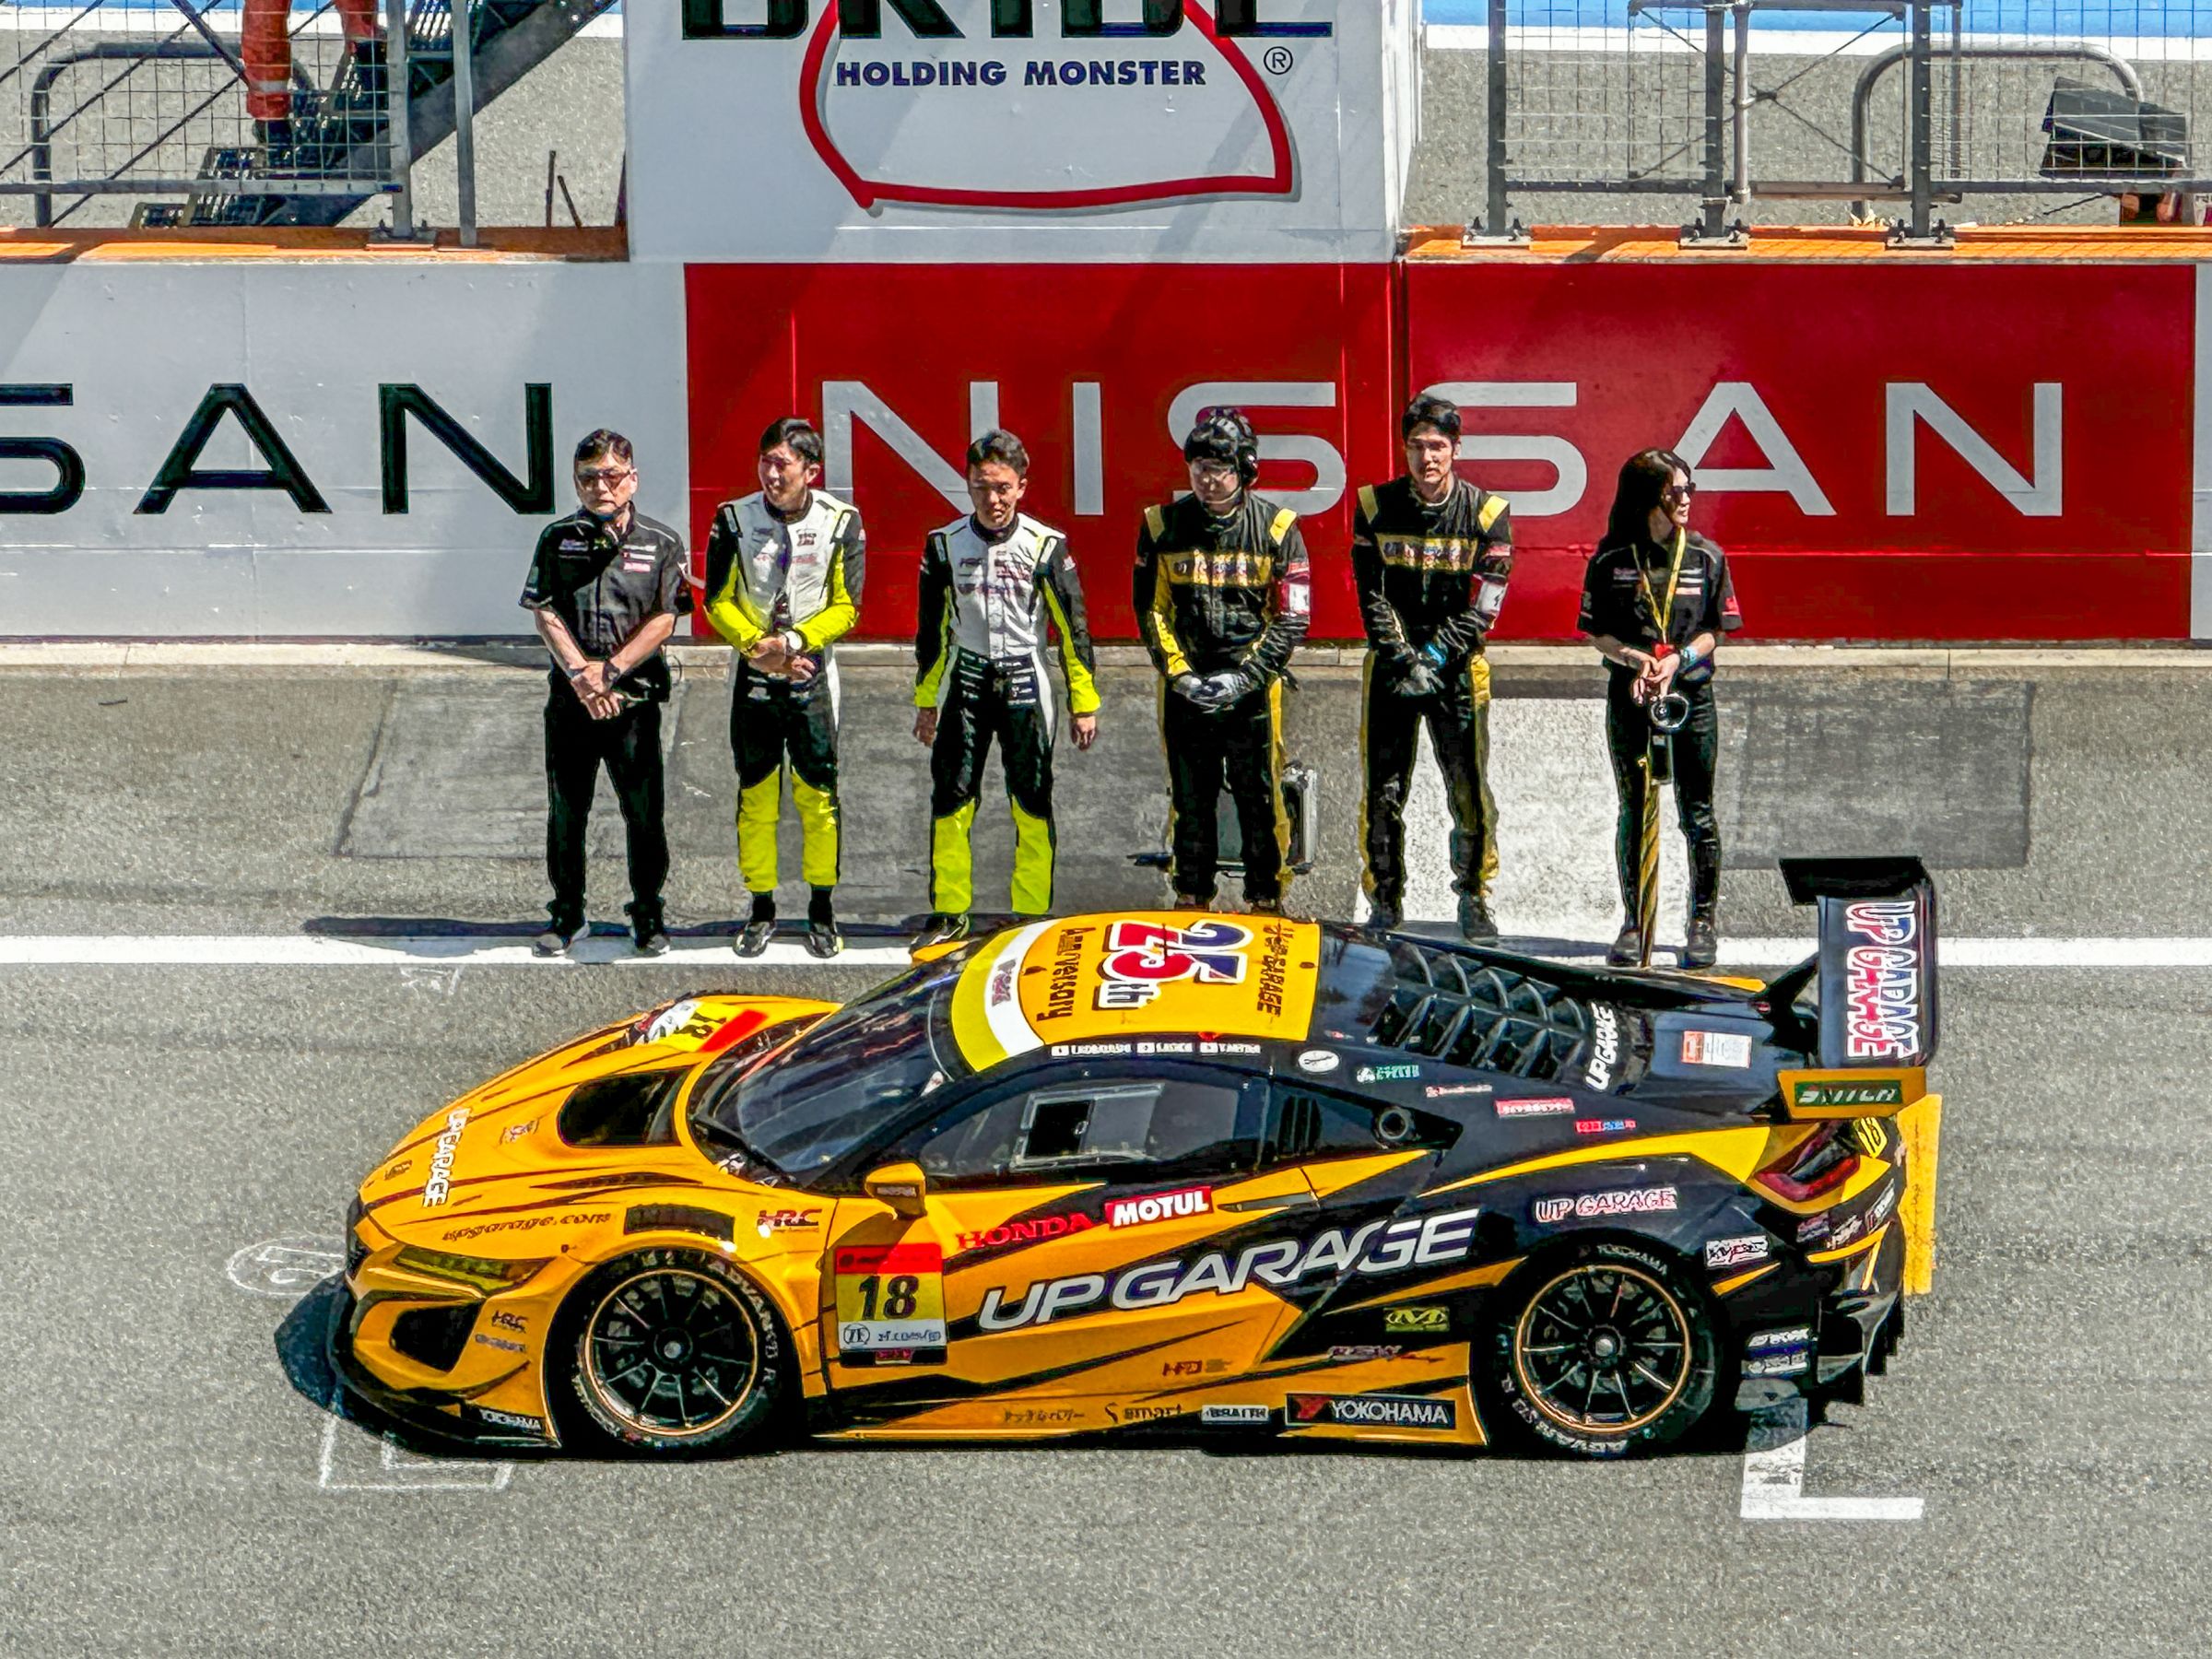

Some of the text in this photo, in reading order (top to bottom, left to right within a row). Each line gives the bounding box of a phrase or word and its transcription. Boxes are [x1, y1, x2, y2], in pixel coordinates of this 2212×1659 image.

[836, 61, 1206, 86] HOLDING MONSTER
[821, 379, 2064, 517] NISSAN
[1112, 1191, 1209, 1227] MOTUL
[1534, 1187, 1678, 1223] UP GARAGE
[956, 1212, 1093, 1251] HONDA
[978, 1208, 1481, 1331] UP GARAGE
[858, 1275, 920, 1320] 18
[1331, 1399, 1449, 1424] YOKOHAMA
